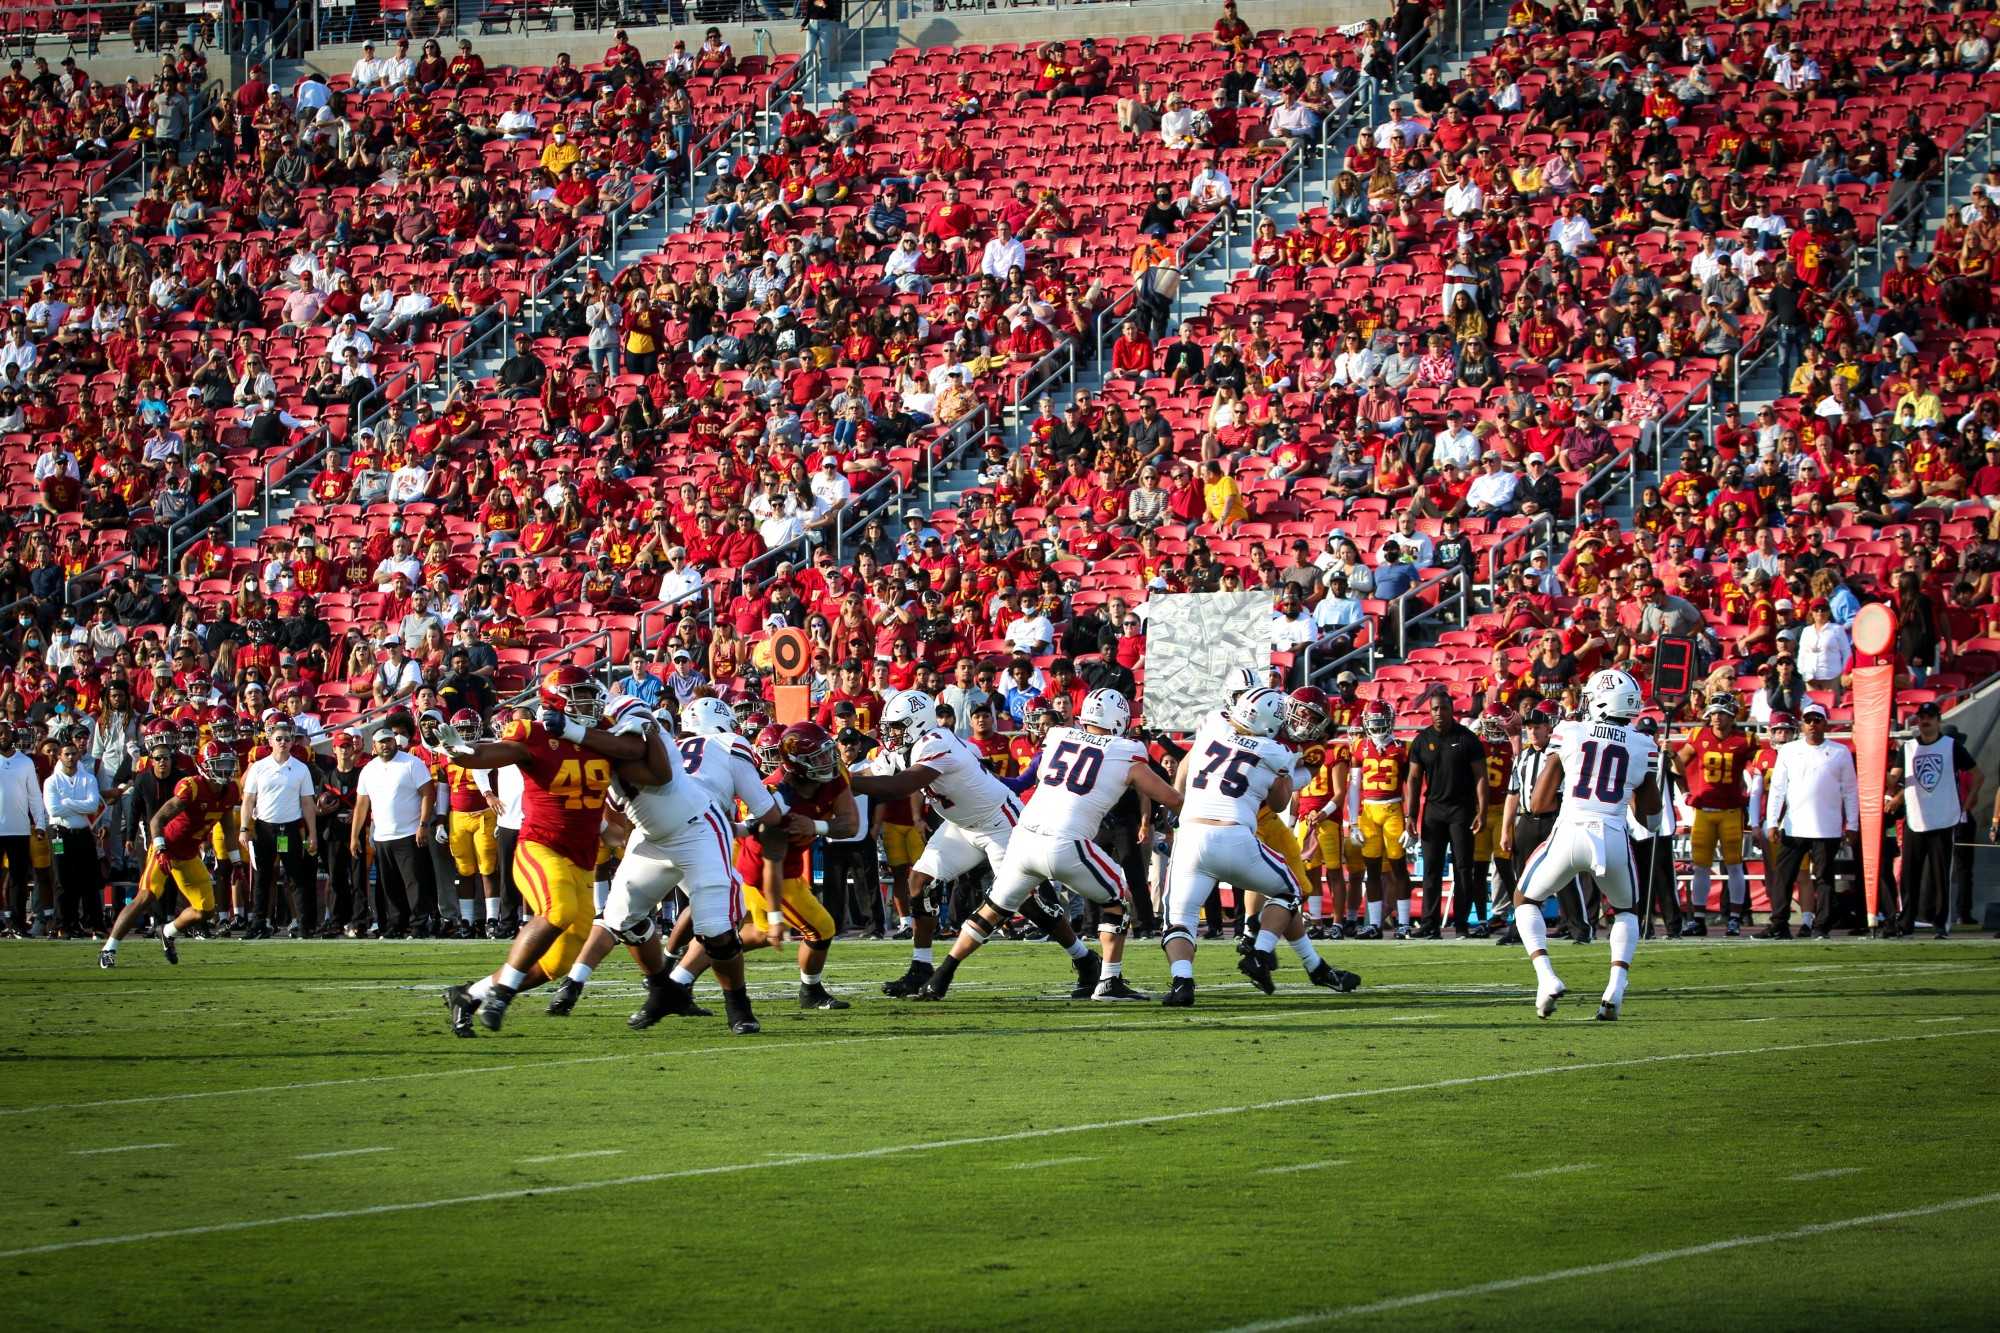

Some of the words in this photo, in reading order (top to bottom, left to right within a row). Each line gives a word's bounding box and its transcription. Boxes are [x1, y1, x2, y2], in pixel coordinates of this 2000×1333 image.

[1334, 241, 1346, 258] 7
[697, 423, 719, 435] USC
[1914, 452, 1930, 473] 2
[531, 532, 545, 552] 7
[609, 544, 631, 564] 43
[346, 567, 368, 579] USC
[588, 581, 613, 592] USC
[1659, 639, 1691, 694] 3
[1597, 674, 1614, 690] A
[908, 696, 926, 714] A
[1590, 725, 1627, 743] JOINER
[1043, 740, 1105, 796] 50
[1192, 740, 1262, 799] 75
[1362, 758, 1399, 791] 23
[1572, 740, 1630, 804] 10
[1703, 751, 1733, 784] 81
[549, 759, 611, 810] 49
[1922, 773, 1936, 786] 12
